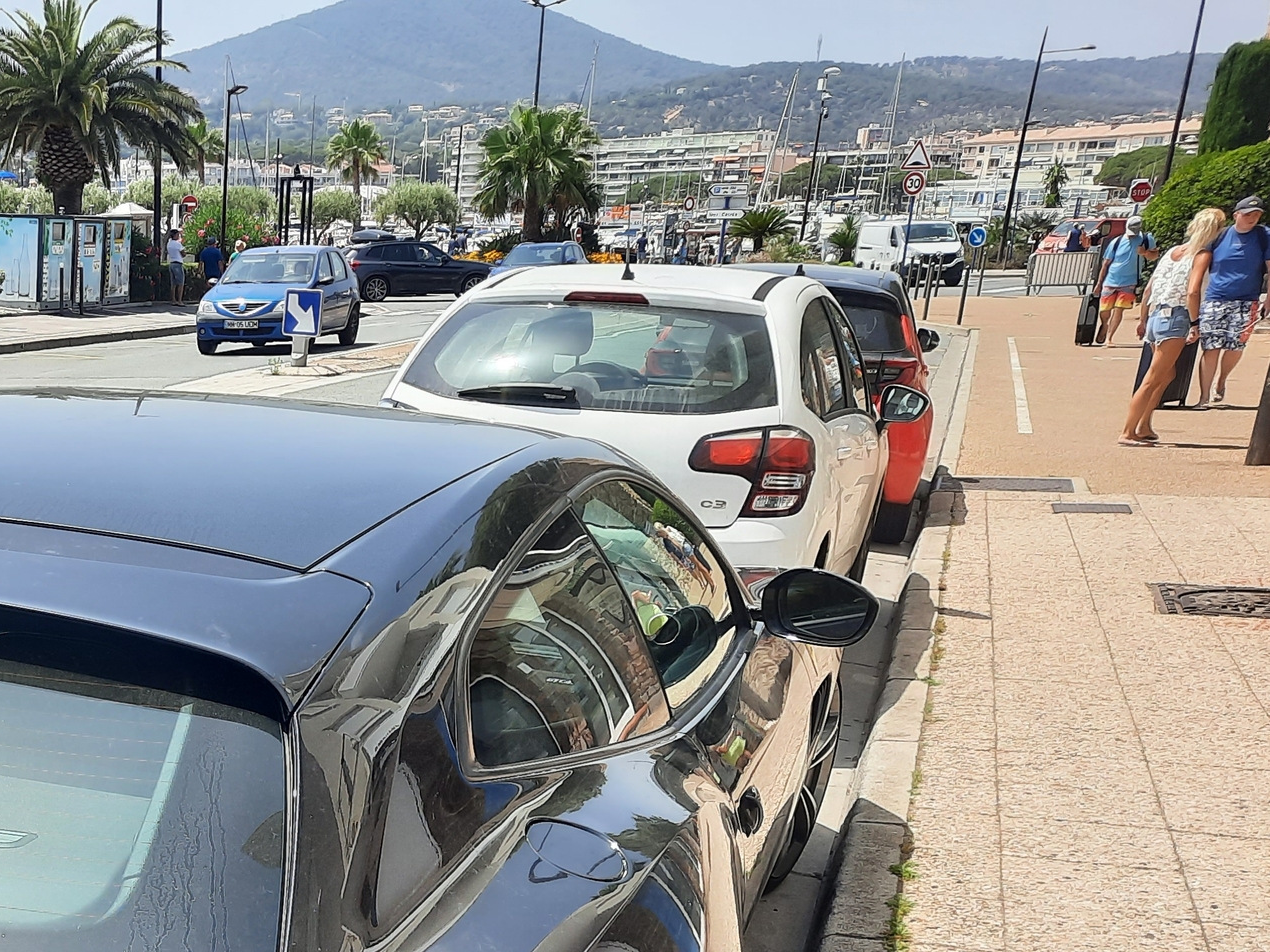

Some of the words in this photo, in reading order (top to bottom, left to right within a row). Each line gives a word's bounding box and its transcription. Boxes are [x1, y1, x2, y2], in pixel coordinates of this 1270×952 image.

[907, 178, 920, 189] 30
[1131, 188, 1151, 197] STOP
[700, 499, 727, 509] C3
